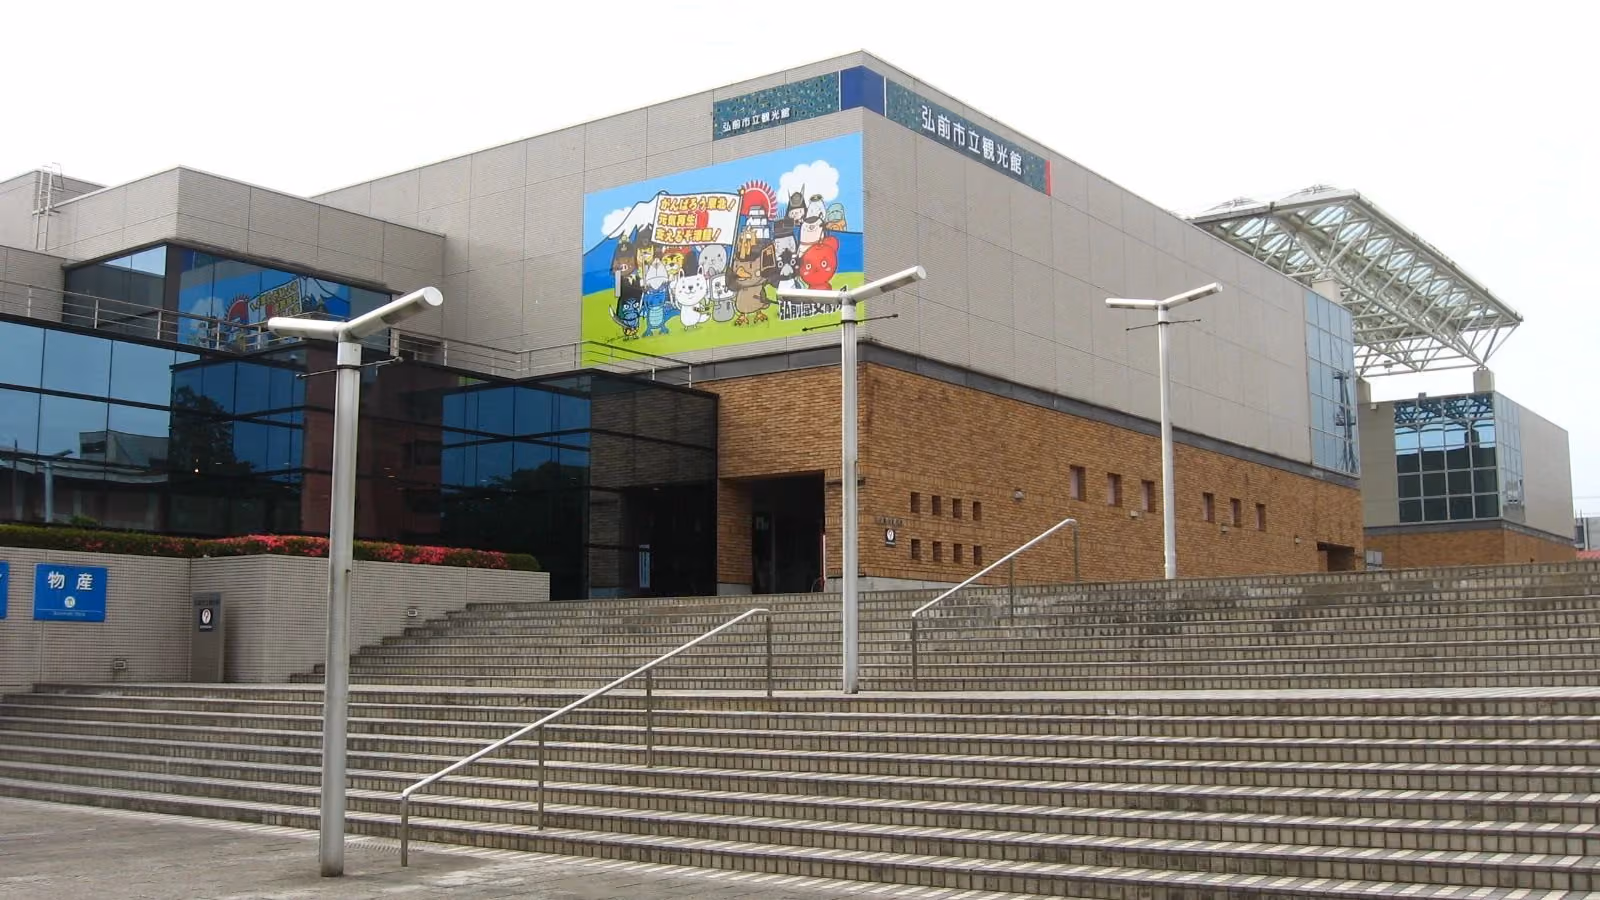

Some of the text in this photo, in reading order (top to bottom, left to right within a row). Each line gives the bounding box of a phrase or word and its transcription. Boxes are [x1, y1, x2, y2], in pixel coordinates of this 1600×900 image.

[721, 106, 791, 133] 弘前市立観光館
[920, 104, 1024, 176] 弘前市立観光館
